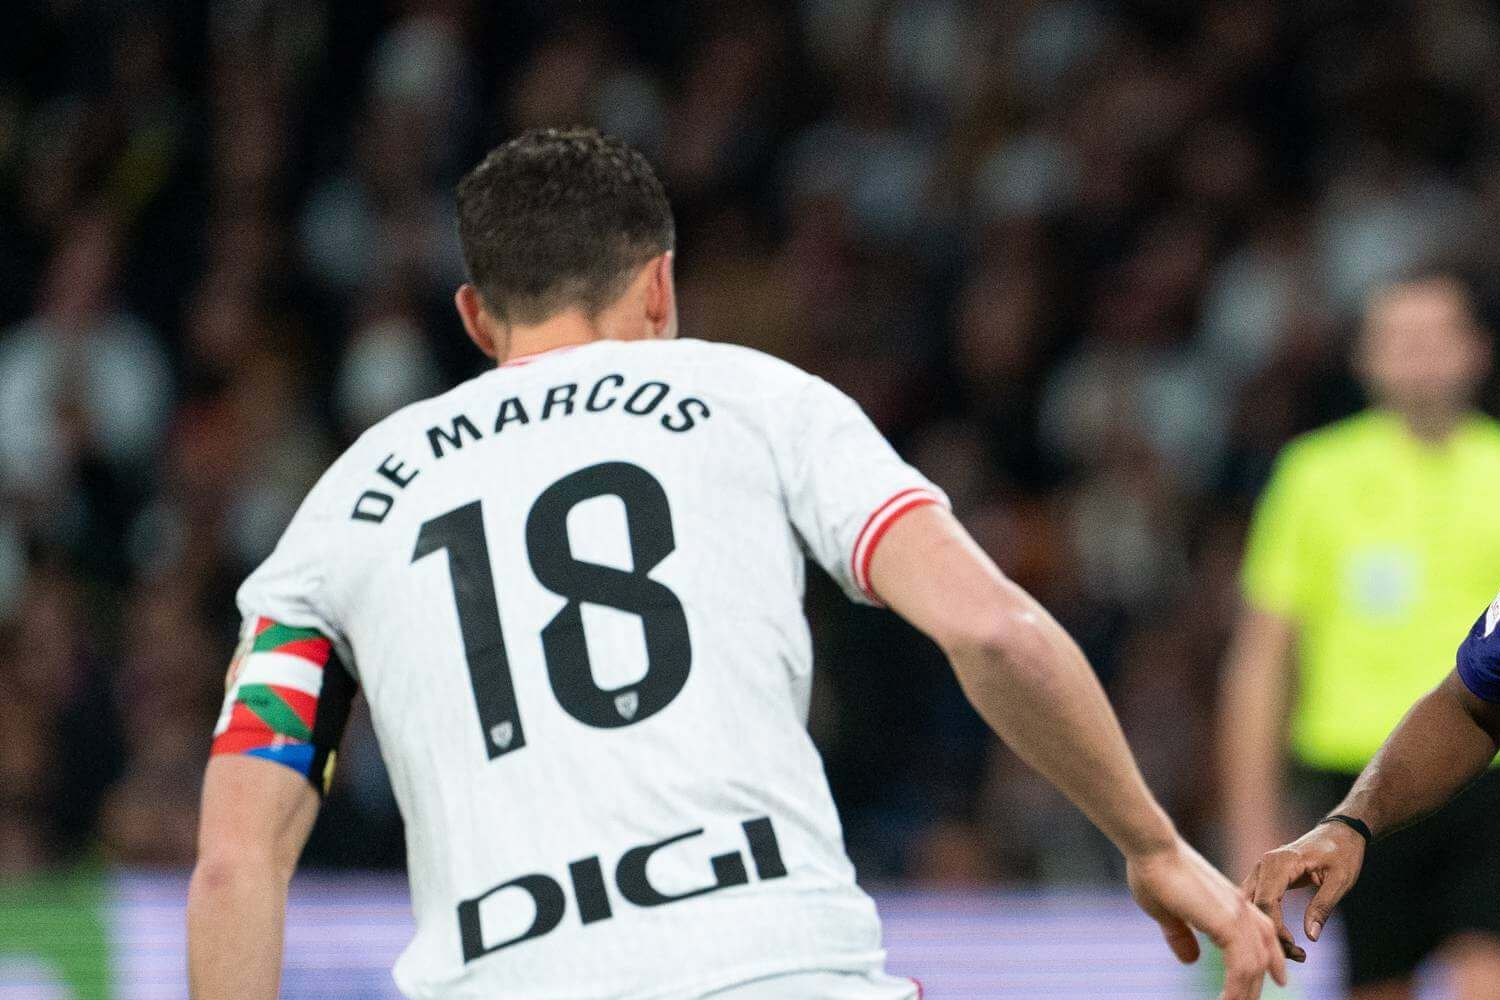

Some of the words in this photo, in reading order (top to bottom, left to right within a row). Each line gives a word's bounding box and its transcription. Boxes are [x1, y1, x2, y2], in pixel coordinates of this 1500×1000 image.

[351, 454, 419, 524] DE
[426, 374, 711, 459] MARCOS
[411, 461, 692, 760] 18
[457, 817, 788, 964] DIGI
